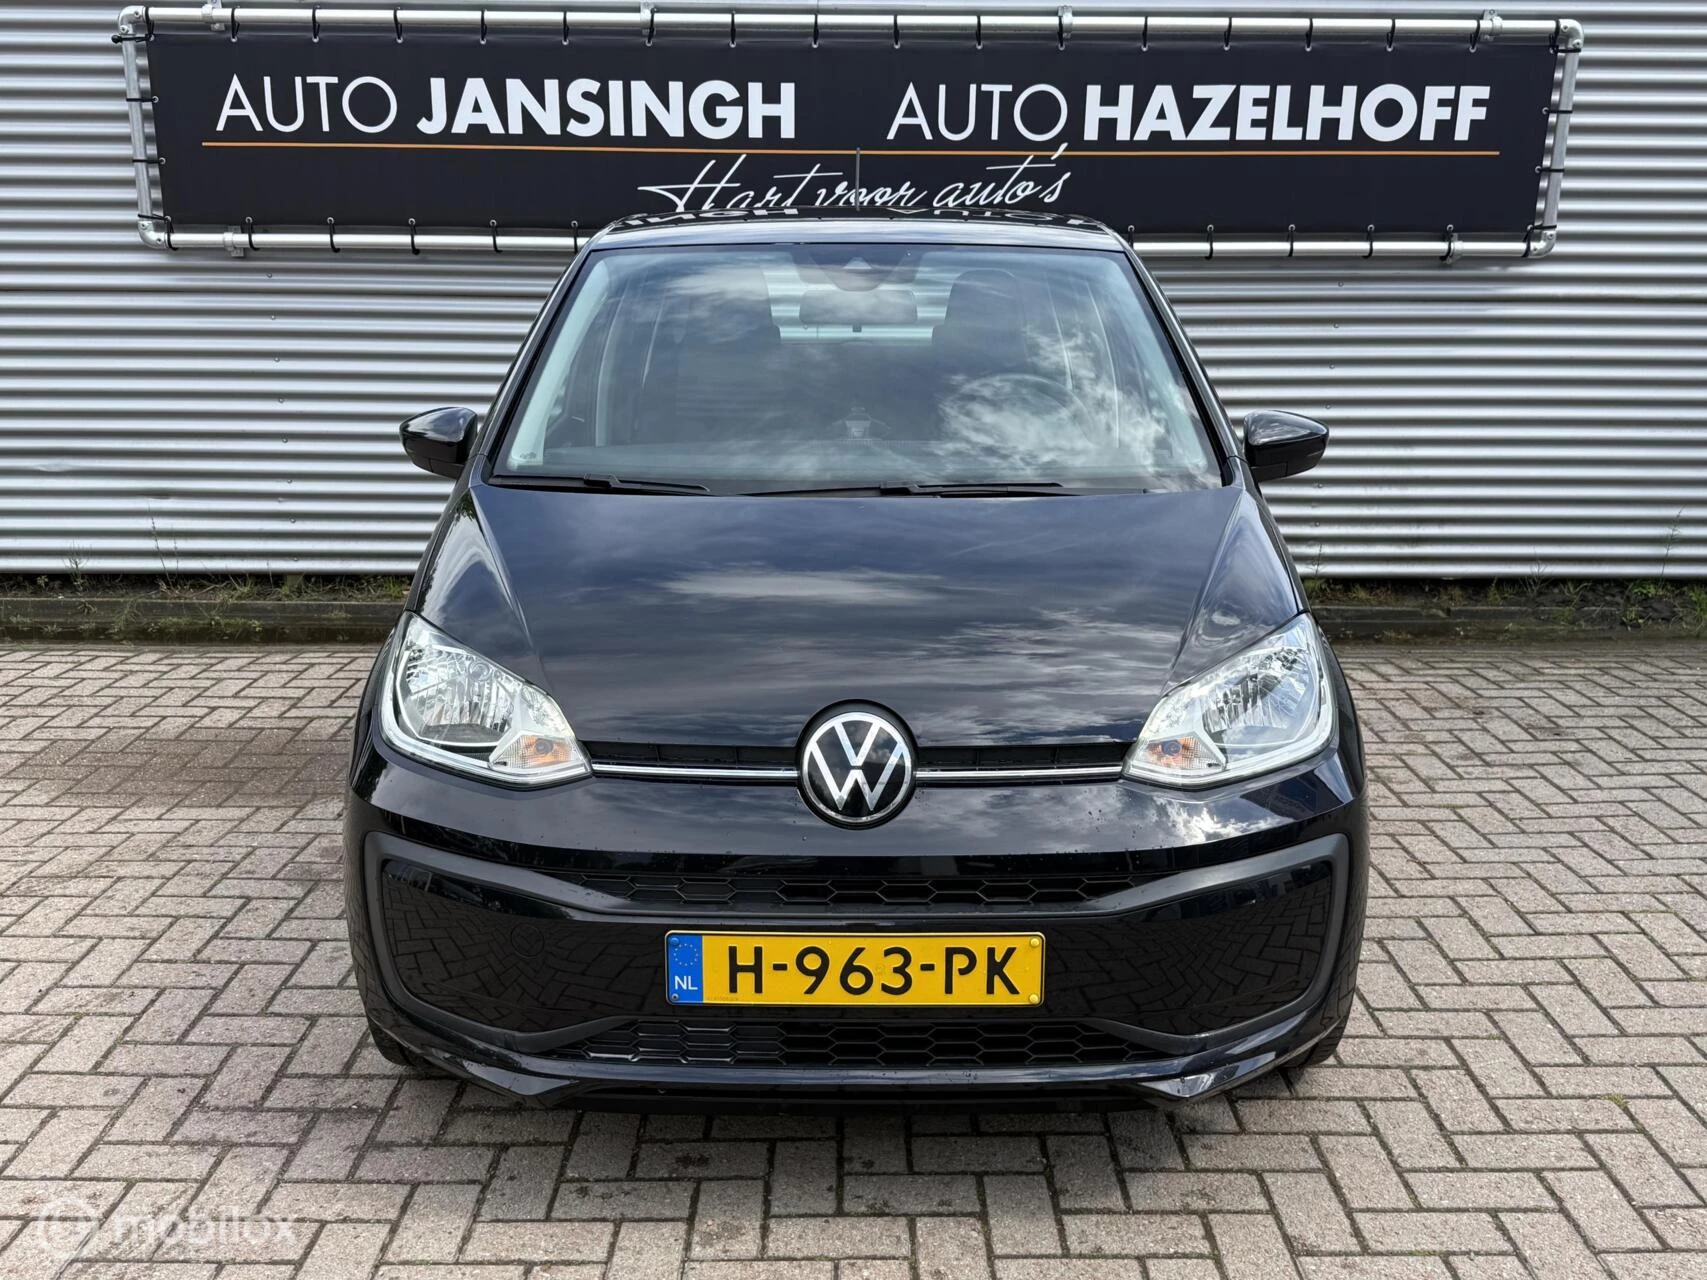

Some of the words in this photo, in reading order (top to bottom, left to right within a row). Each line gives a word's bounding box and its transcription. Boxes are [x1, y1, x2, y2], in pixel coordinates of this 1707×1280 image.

[216, 73, 398, 134] AUTO
[416, 77, 796, 140] JANSINGH
[887, 82, 1069, 142] AUTO
[1083, 83, 1491, 142] HAZELHOFF
[637, 153, 844, 211] Hart
[932, 142, 1071, 208] auto's
[673, 975, 698, 991] NL
[727, 945, 1020, 996] H-963-PK
